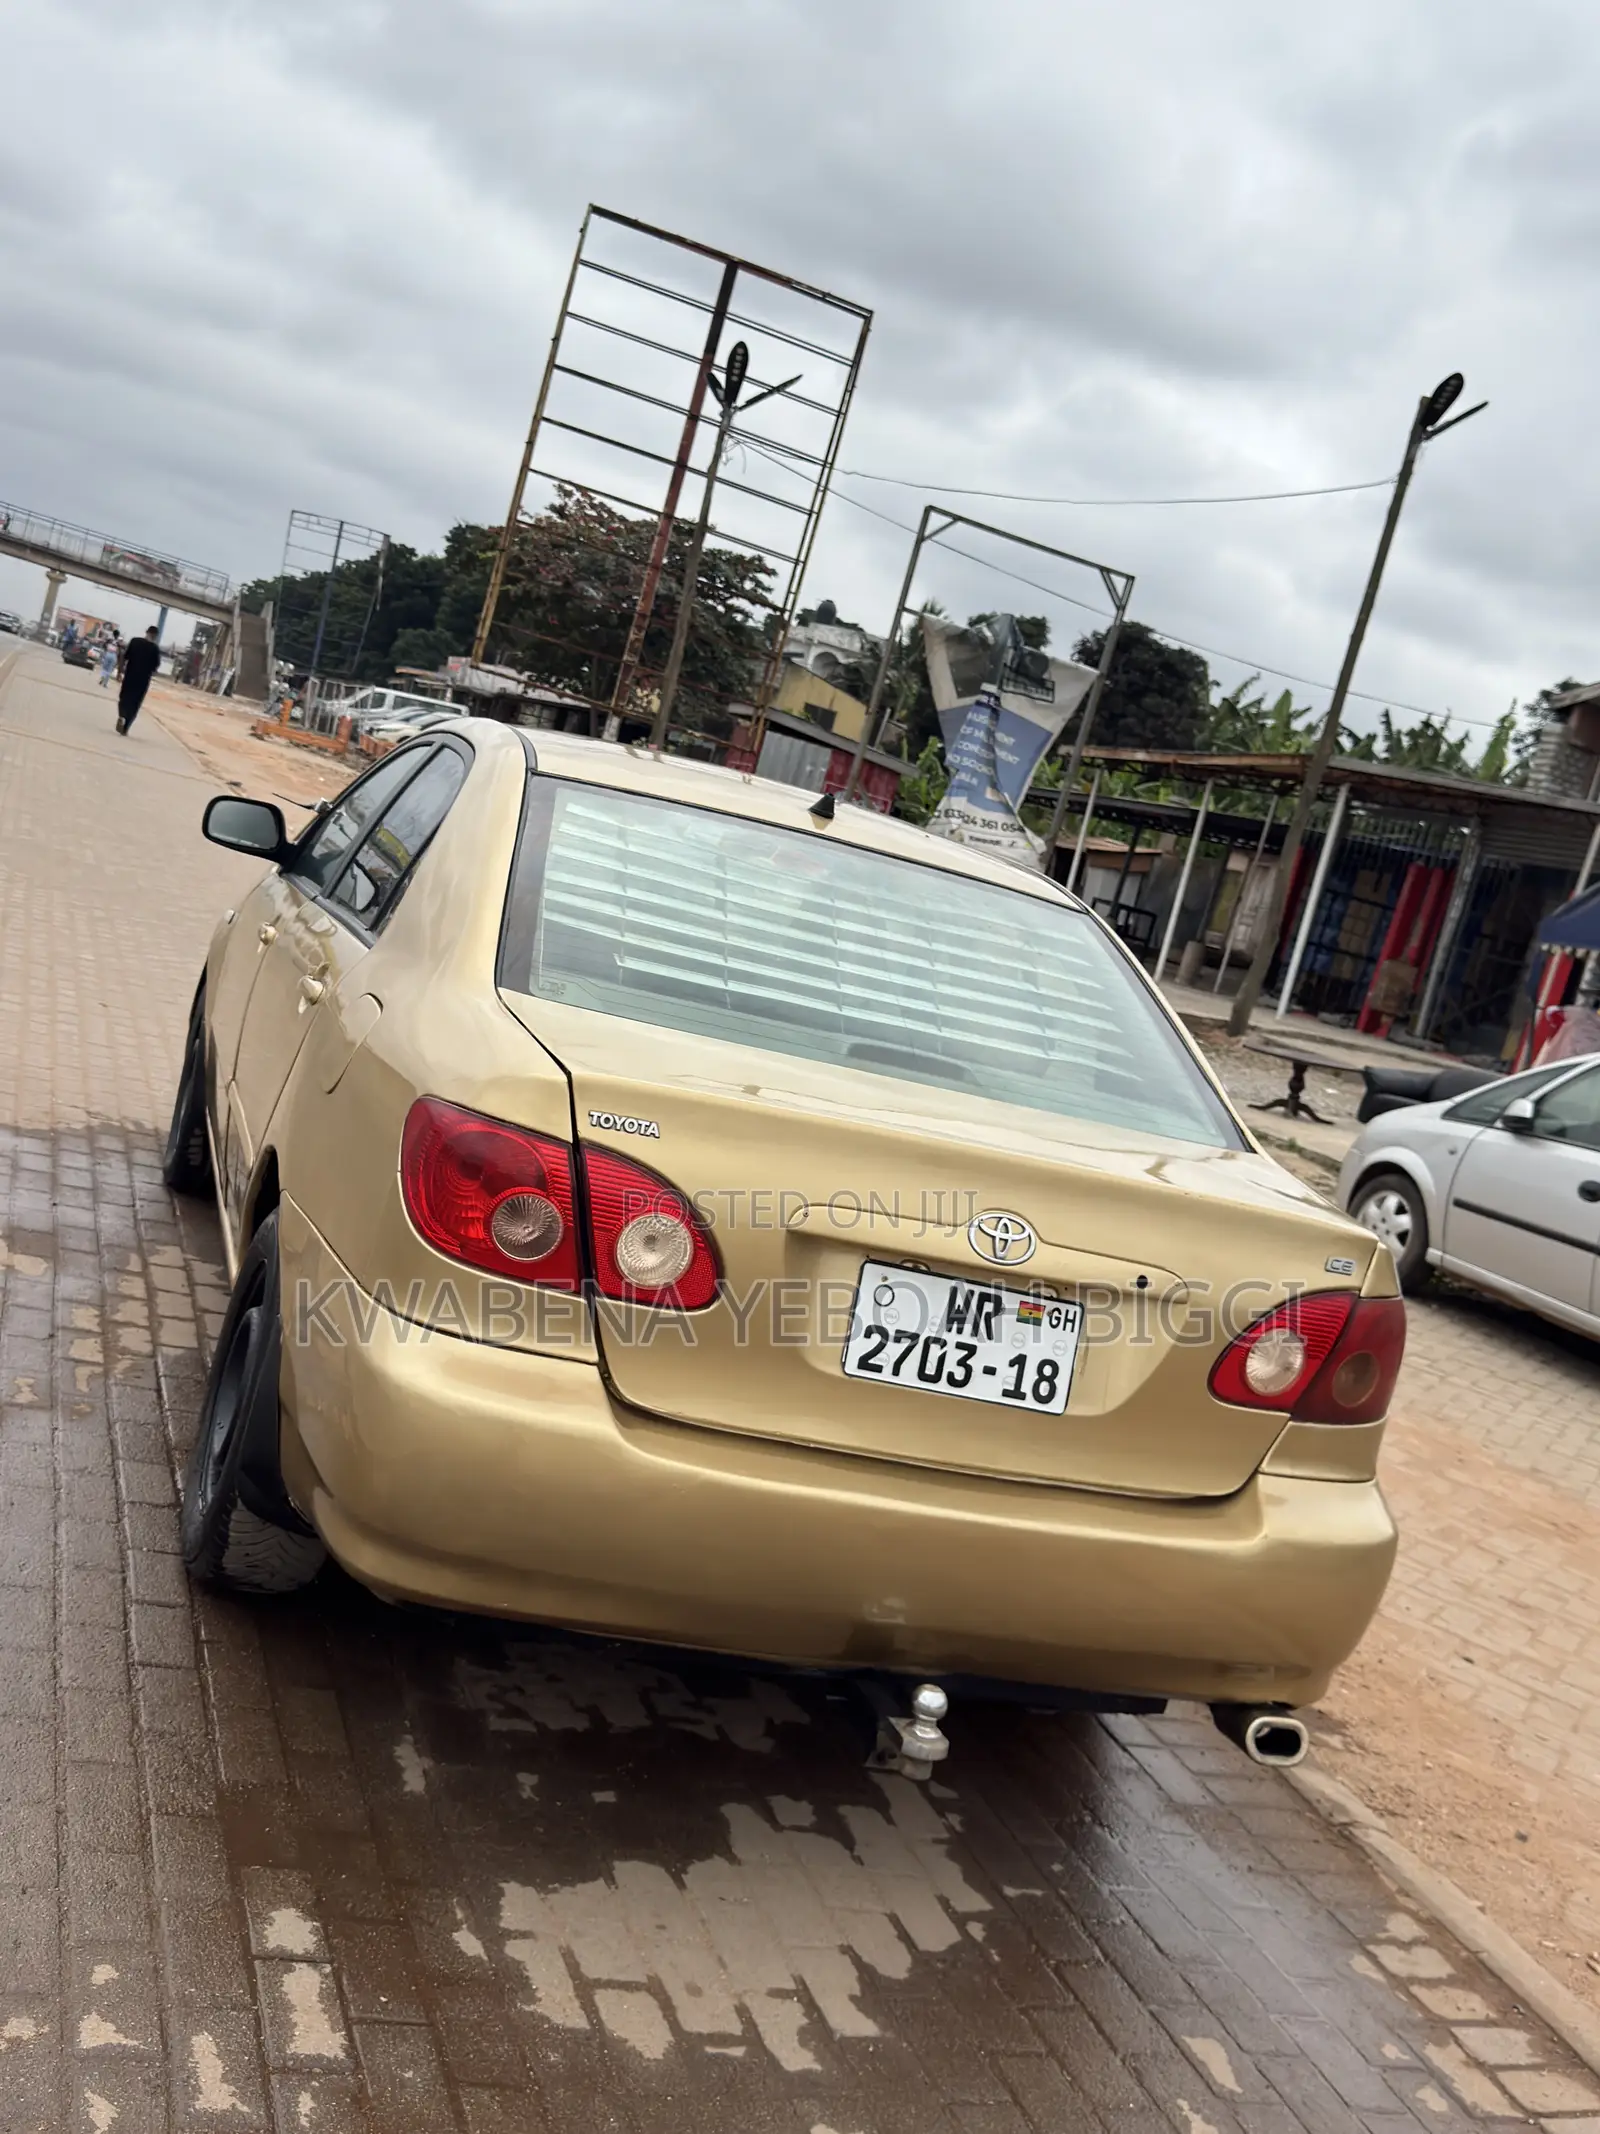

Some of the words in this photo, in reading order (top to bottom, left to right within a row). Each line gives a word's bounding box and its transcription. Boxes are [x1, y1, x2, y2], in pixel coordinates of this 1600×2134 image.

[979, 818, 999, 830] 361
[588, 1110, 660, 1138] TOYOTA
[1330, 1258, 1354, 1273] CE
[945, 1285, 1003, 1341] WR
[1048, 1306, 1078, 1333] GH
[857, 1324, 1060, 1405] 2703-18
